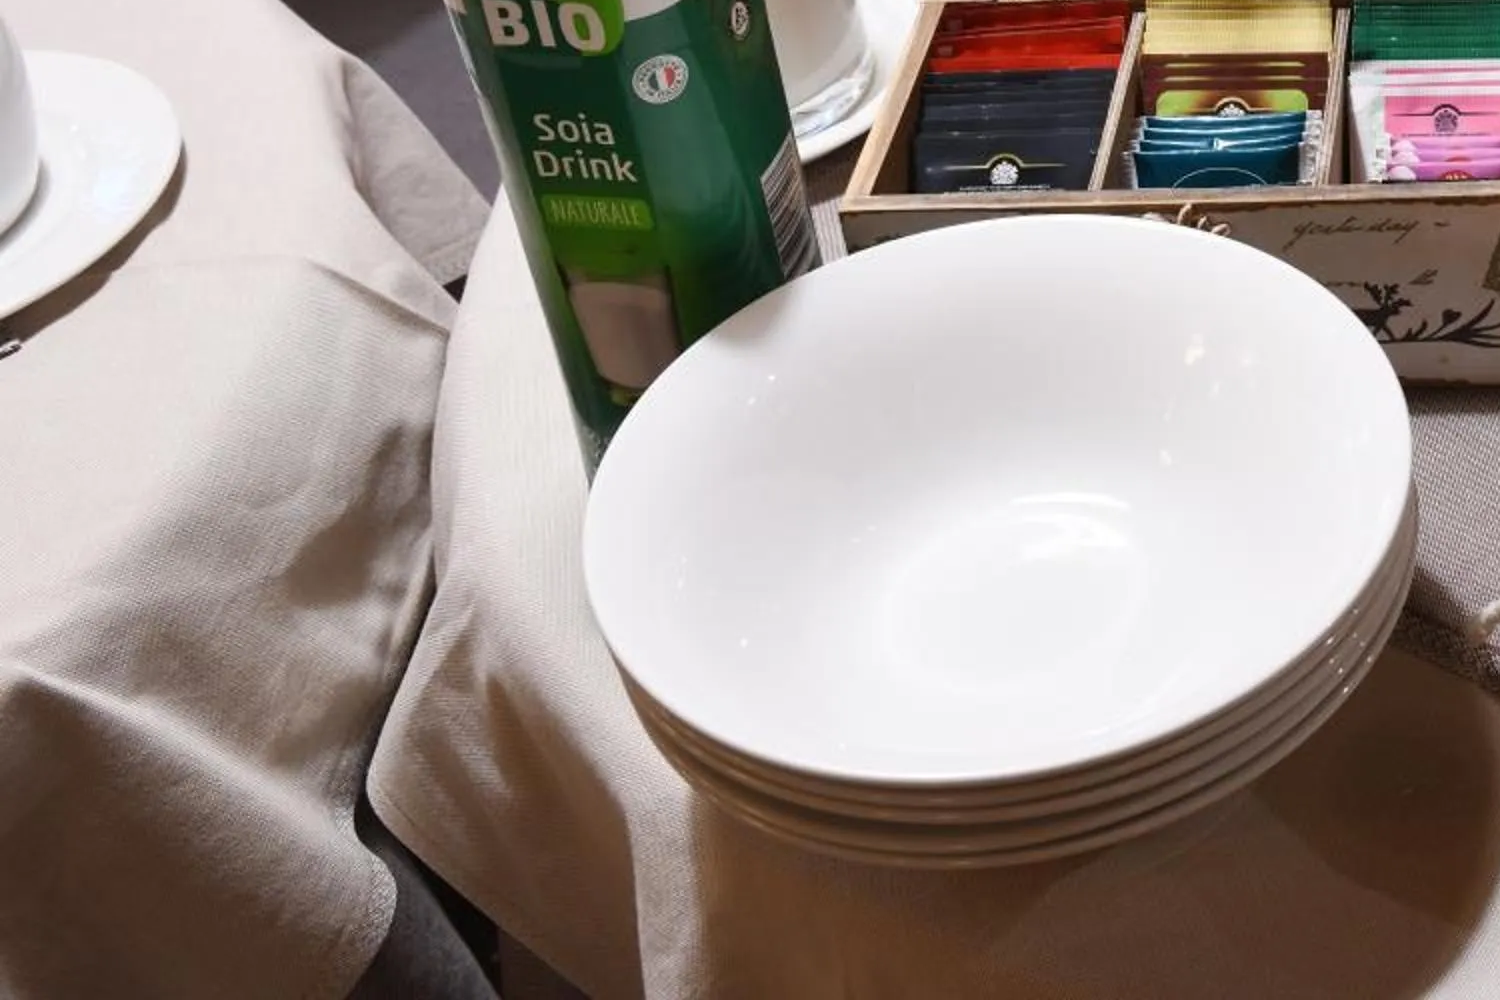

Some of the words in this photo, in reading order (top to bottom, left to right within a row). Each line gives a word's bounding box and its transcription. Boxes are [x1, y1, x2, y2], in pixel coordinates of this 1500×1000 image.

[533, 113, 616, 145] Soia
[533, 150, 638, 182] Drink
[550, 199, 642, 227] NATURALE
